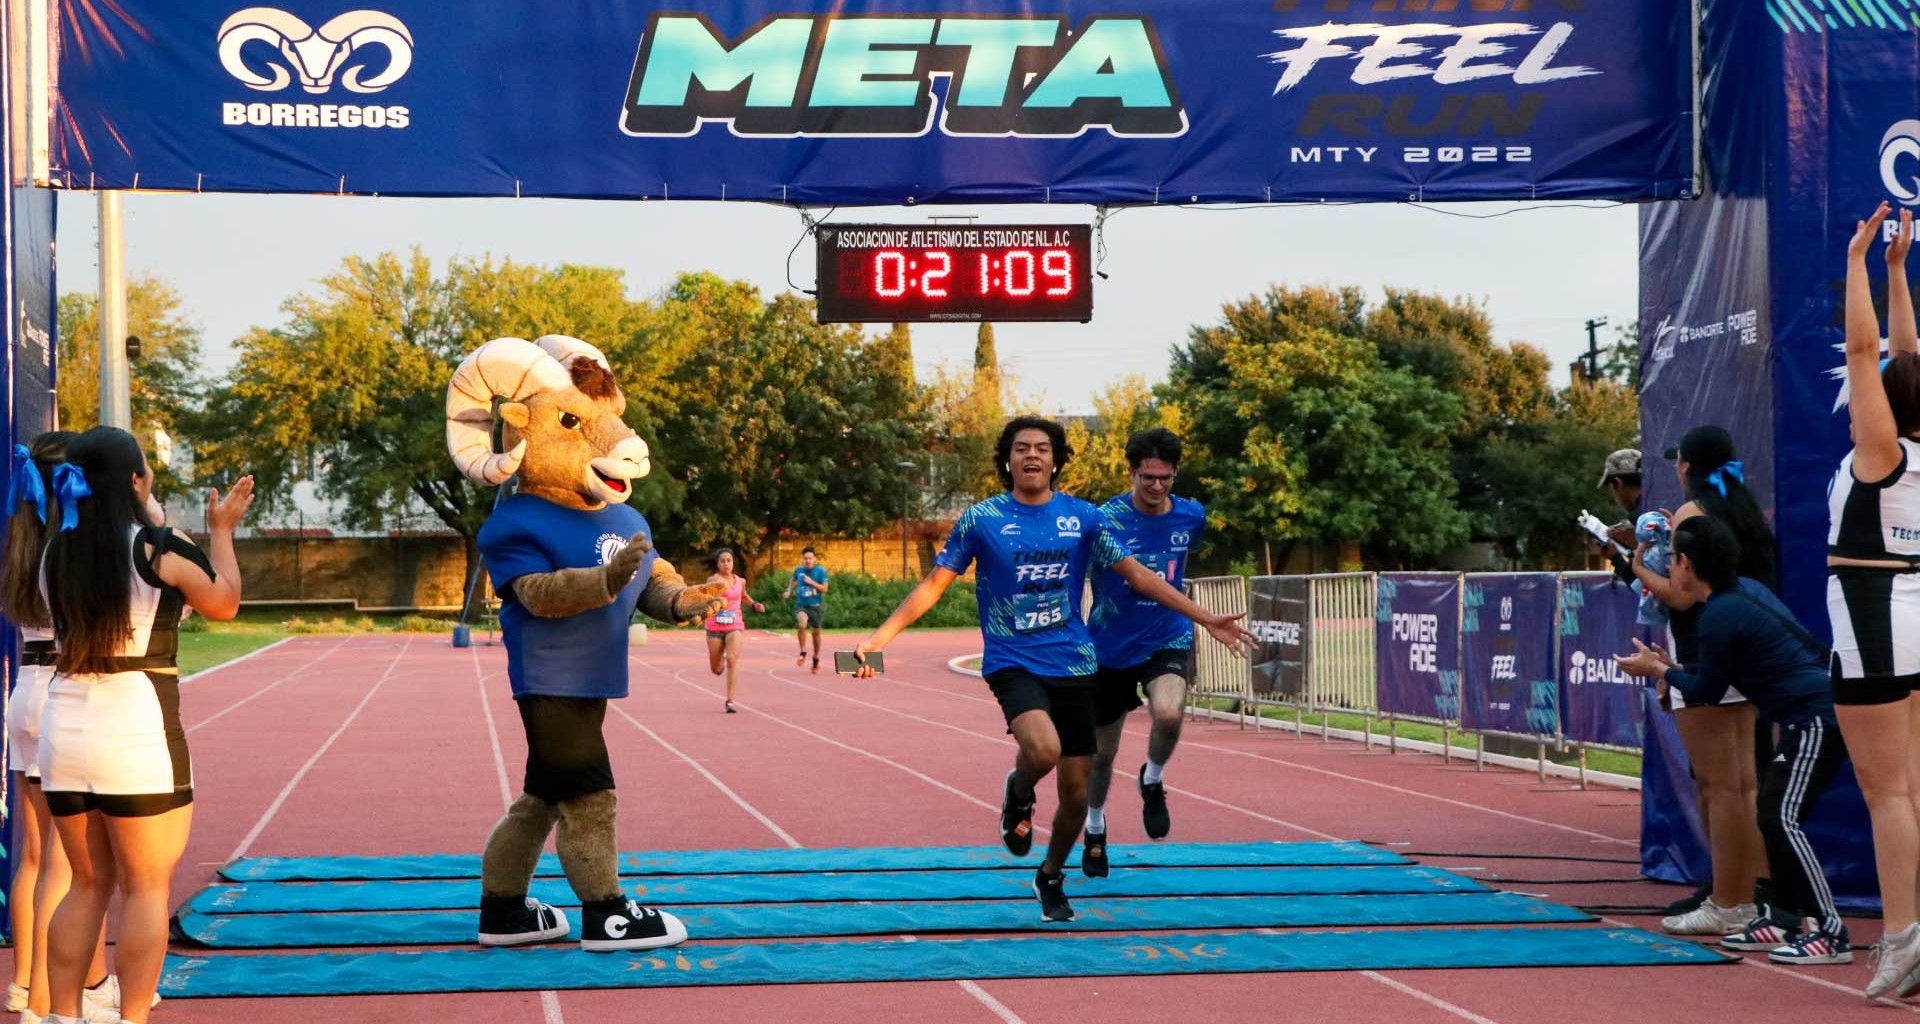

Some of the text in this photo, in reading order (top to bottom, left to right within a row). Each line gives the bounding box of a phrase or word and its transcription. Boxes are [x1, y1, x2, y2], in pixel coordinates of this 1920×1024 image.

[1257, 20, 1604, 96] FEEL
[625, 14, 1186, 132] META
[223, 103, 410, 128] BORREGOS
[1297, 94, 1547, 138] RUN
[1290, 146, 1533, 163] MTY 2022
[837, 231, 894, 249] ASOCIACION
[895, 231, 909, 248] DE
[911, 230, 962, 248] ATLETISMO
[963, 230, 982, 248] DEL
[983, 230, 1020, 247] ESTADO
[1021, 230, 1034, 247] DE
[1689, 310, 1757, 341] BANORTE POWER
[1016, 562, 1070, 582] FEEL
[1026, 607, 1062, 629] 765
[1392, 612, 1438, 643] POWER
[1409, 642, 1438, 673] ADE
[1491, 655, 1517, 681] FEEL
